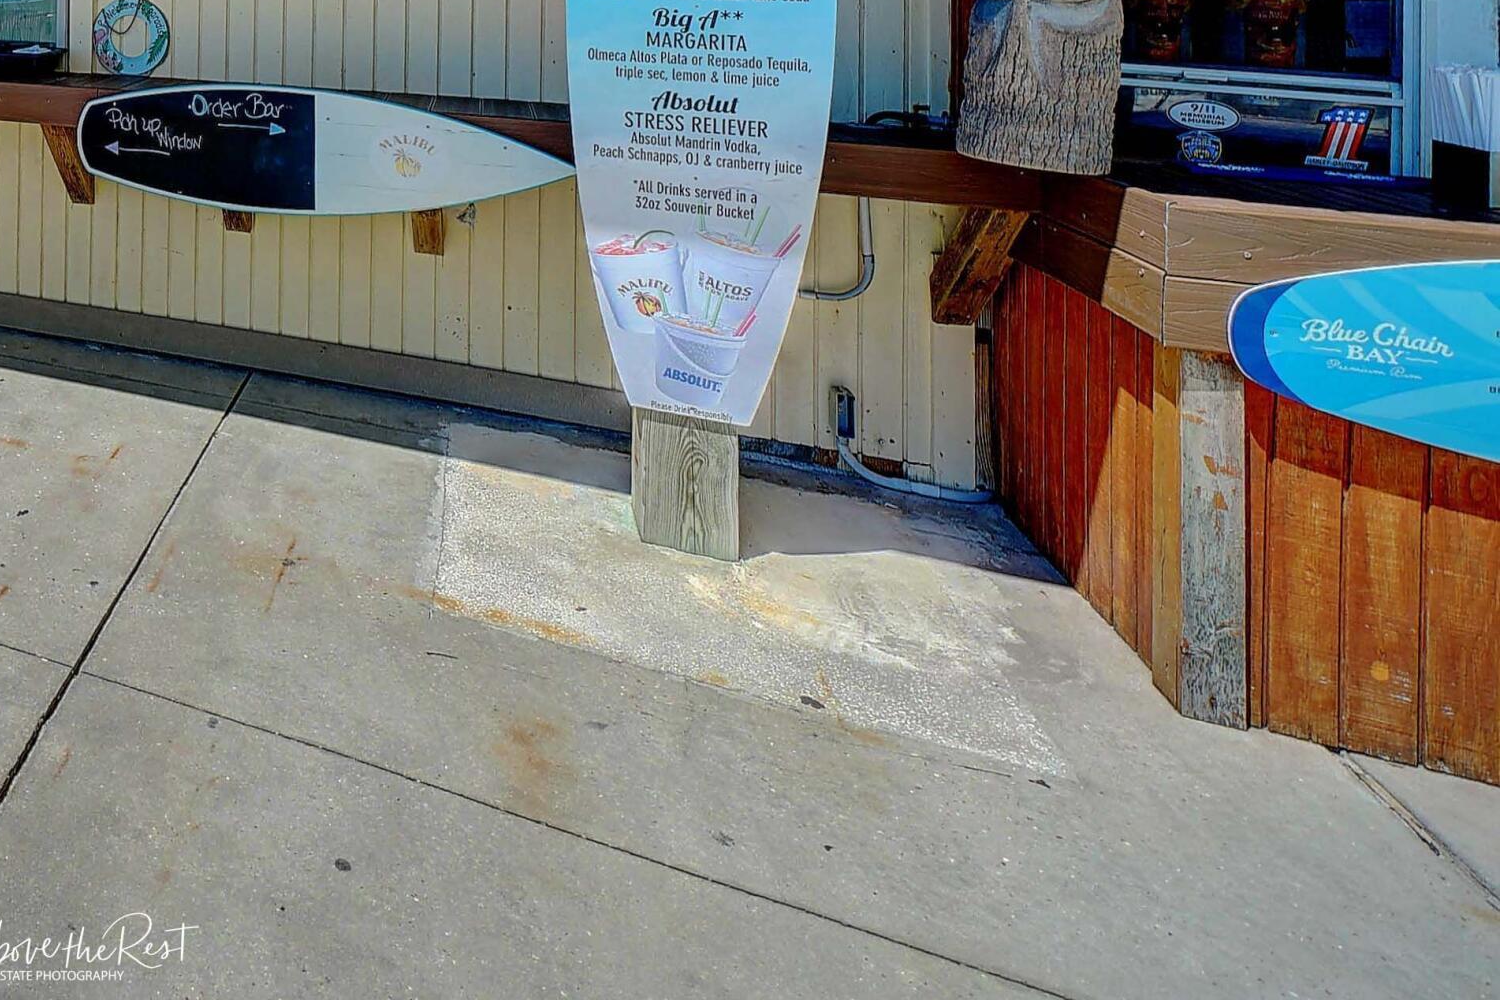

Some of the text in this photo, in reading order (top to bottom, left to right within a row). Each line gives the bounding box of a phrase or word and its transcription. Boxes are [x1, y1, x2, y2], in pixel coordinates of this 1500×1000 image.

[653, 8, 693, 33] Big
[647, 32, 747, 51] MARGARITA
[192, 93, 283, 119] Order Bar
[651, 91, 738, 114] Absolut
[1190, 104, 1215, 114] 9/11
[141, 117, 161, 137] up
[624, 111, 768, 138] STRESS RELIEVER
[1180, 112, 1227, 122] MEMORIAL
[156, 130, 203, 150] Window
[379, 134, 436, 155] MALIBU
[657, 182, 690, 197] Drinks
[695, 187, 732, 201] served
[736, 190, 747, 201] in
[750, 193, 757, 204] a
[636, 196, 754, 220] 32oz Souvenir Bucket
[705, 276, 753, 297] ALTOS
[1300, 319, 1454, 358] Blue Chair
[1347, 344, 1404, 366] BAY
[1327, 359, 1423, 381] Premium Rum
[651, 400, 671, 411] Please
[693, 408, 733, 421] Responsibly
